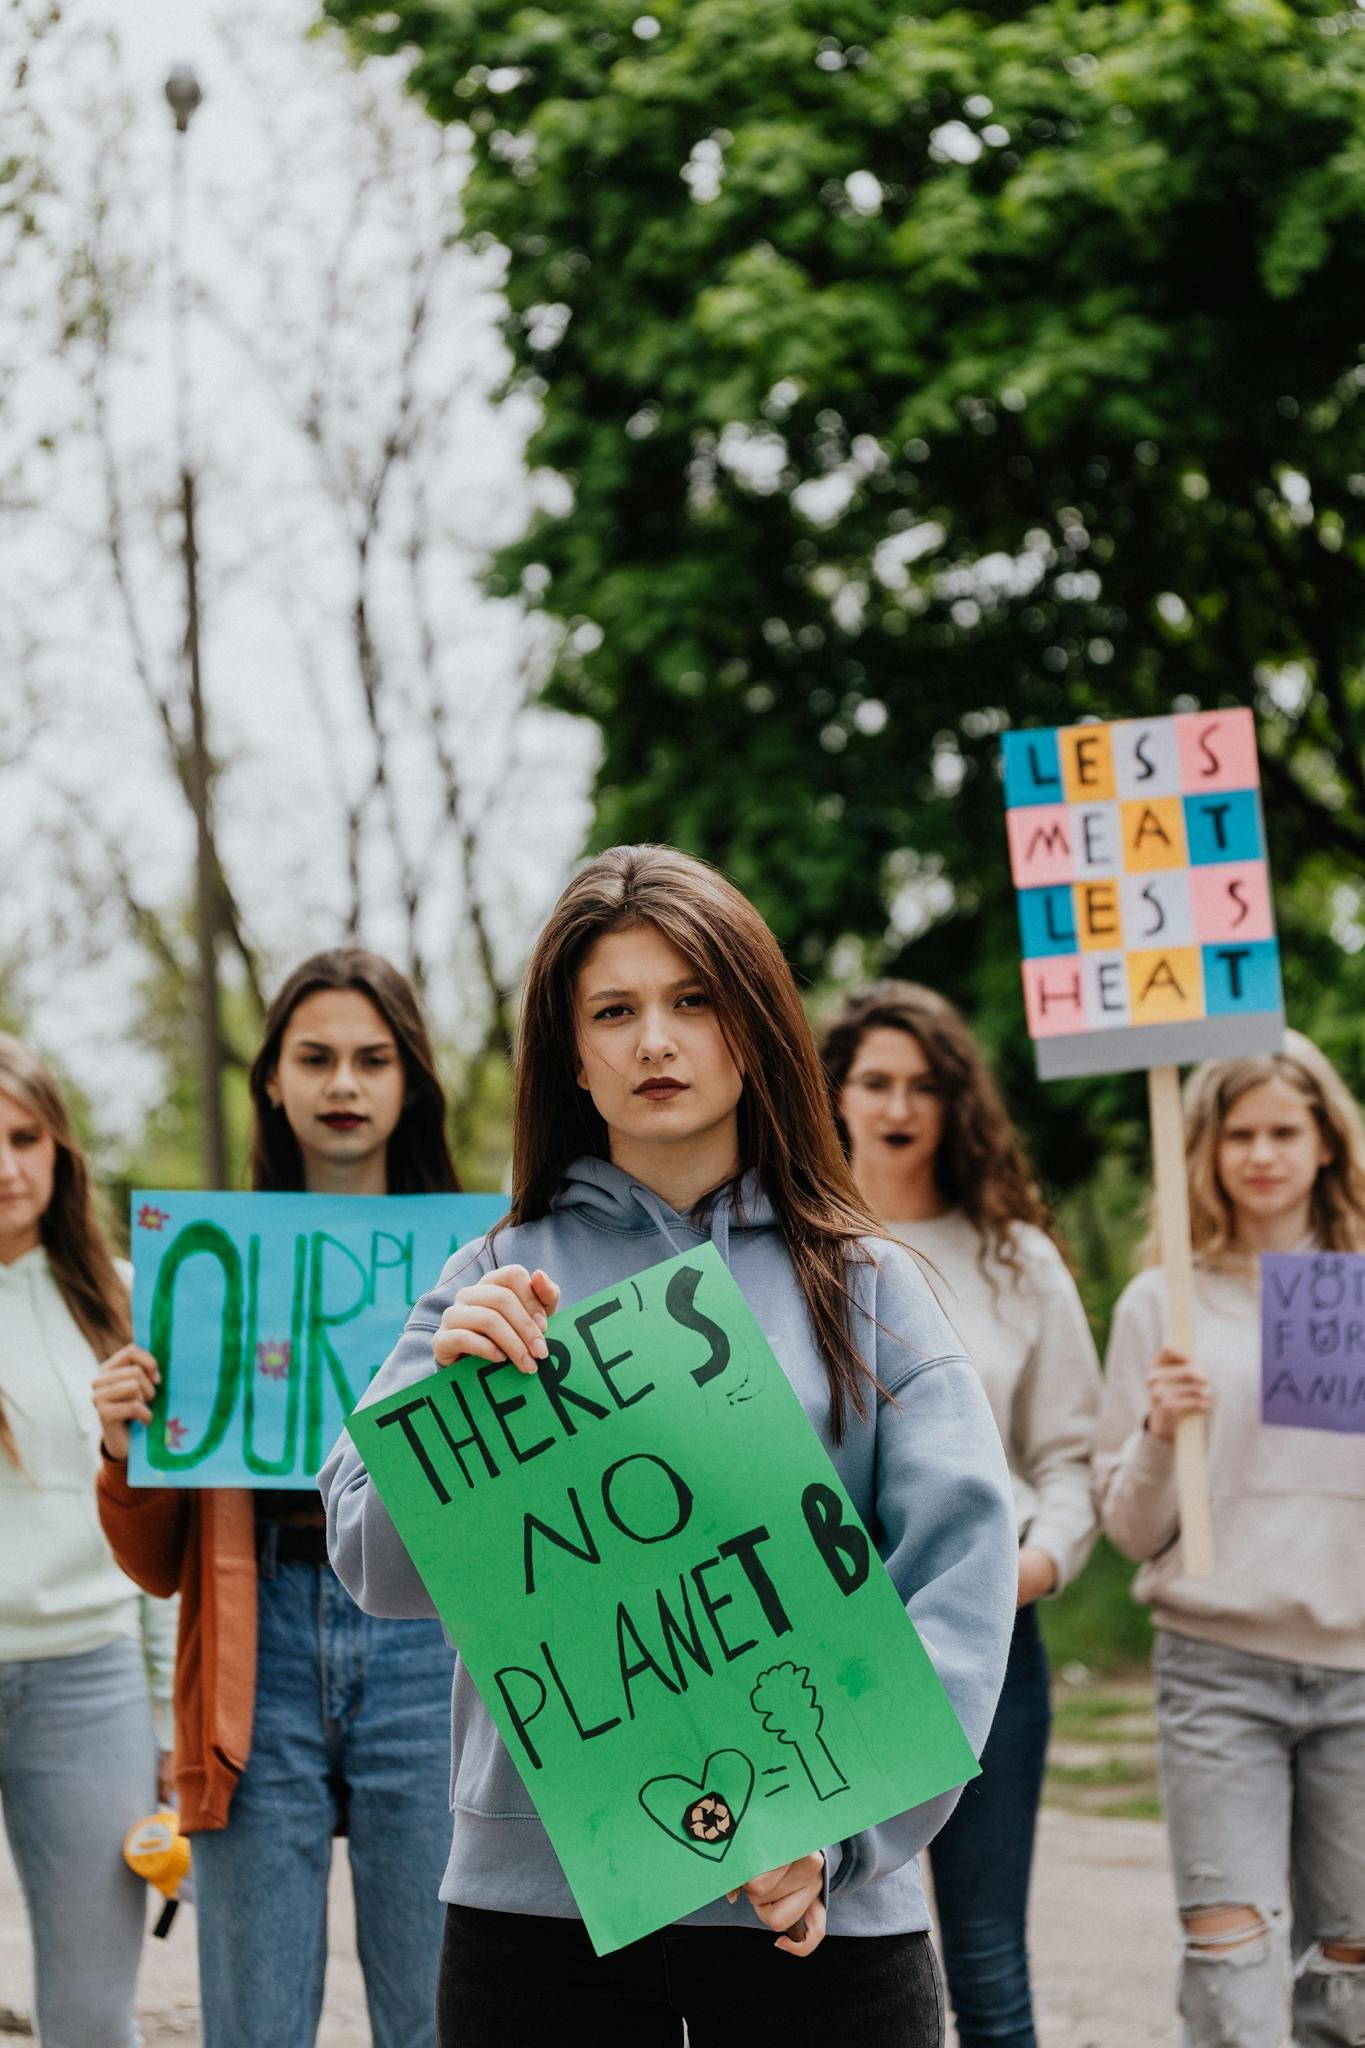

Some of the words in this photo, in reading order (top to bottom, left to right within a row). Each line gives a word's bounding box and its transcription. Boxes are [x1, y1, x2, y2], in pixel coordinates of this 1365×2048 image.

[1028, 722, 1220, 786] LESS
[1025, 804, 1231, 865] MEAT
[1043, 879, 1249, 942] LESS
[1037, 950, 1250, 1015] HEAT
[369, 1230, 458, 1306] PL
[146, 1218, 370, 1476] OUR
[376, 1266, 731, 1506] THERE'S
[524, 1453, 694, 1595] NO
[493, 1525, 792, 1769] PLANET
[801, 1482, 870, 1597] B
